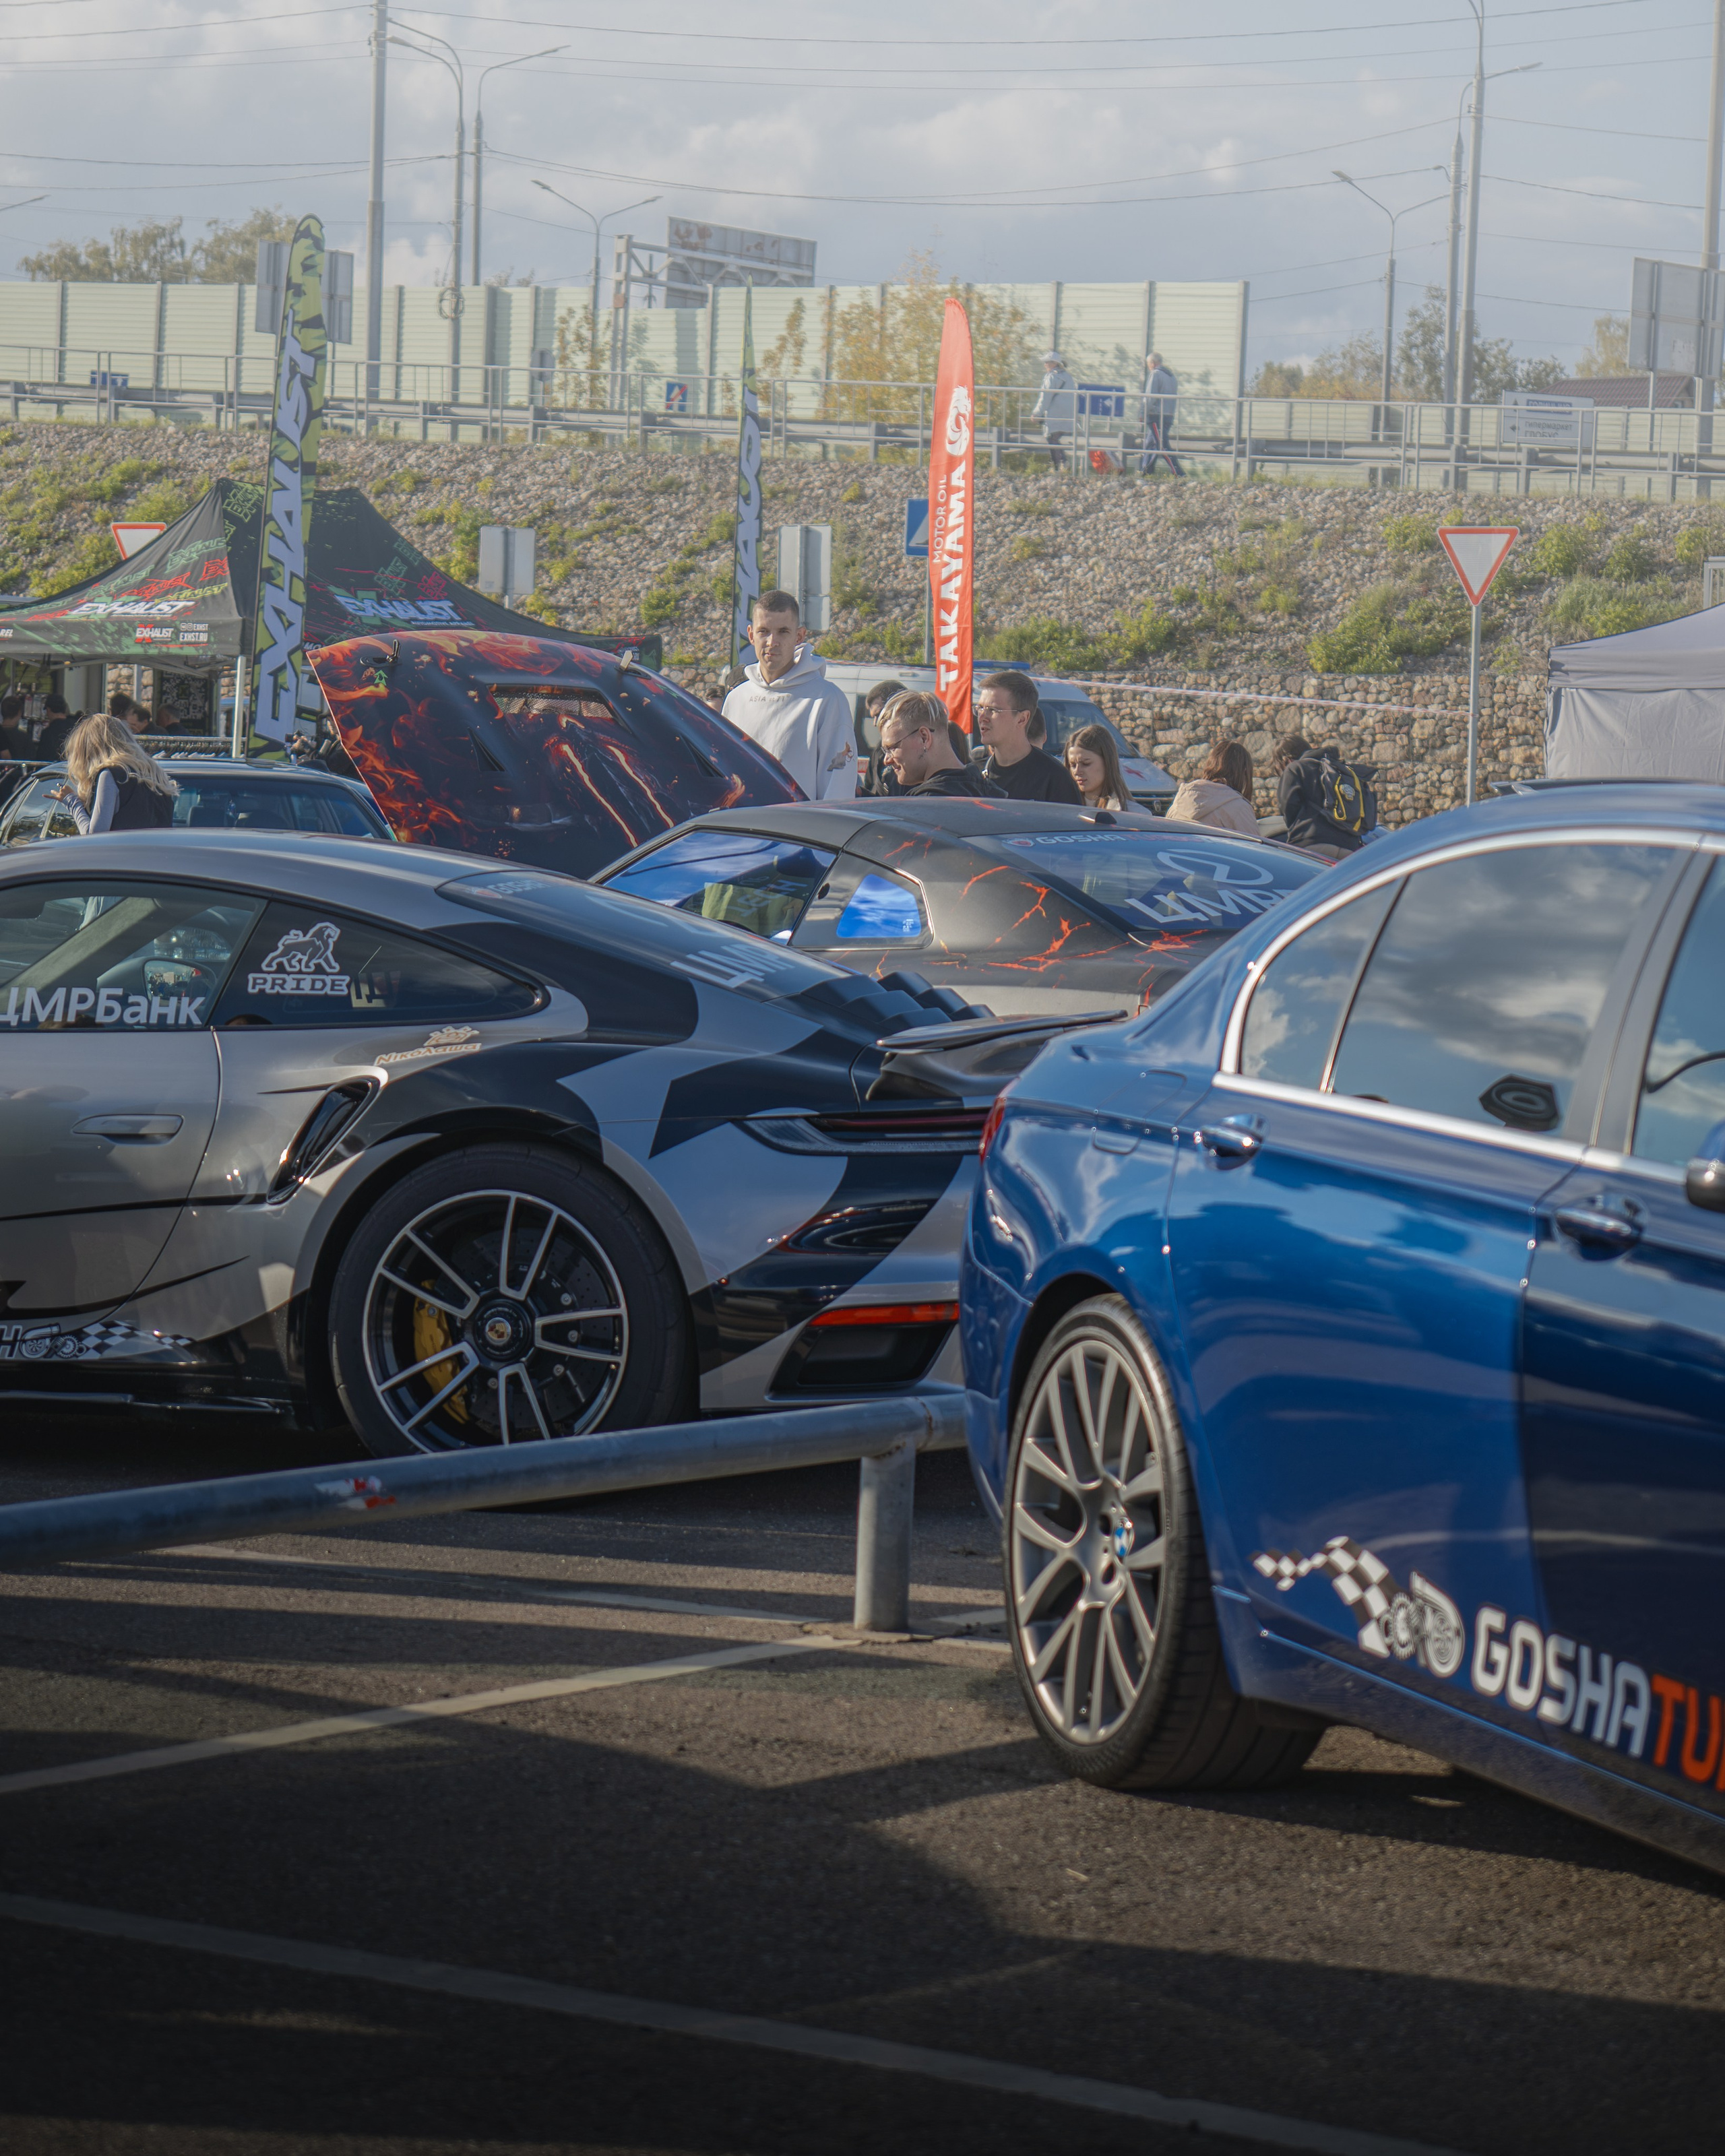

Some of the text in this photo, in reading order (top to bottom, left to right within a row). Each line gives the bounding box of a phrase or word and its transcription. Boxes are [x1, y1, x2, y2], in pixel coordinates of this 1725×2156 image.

[1525, 421, 1573, 431] гипермаркет
[932, 474, 947, 563] MOTOR OIL
[939, 460, 966, 692] TAKAYAMA
[69, 600, 196, 614] EXHAUST
[334, 594, 462, 621] EXHAUST
[135, 624, 174, 642] EXHAUST
[179, 632, 208, 641] EXHST.RU
[249, 974, 348, 994] PRIDE
